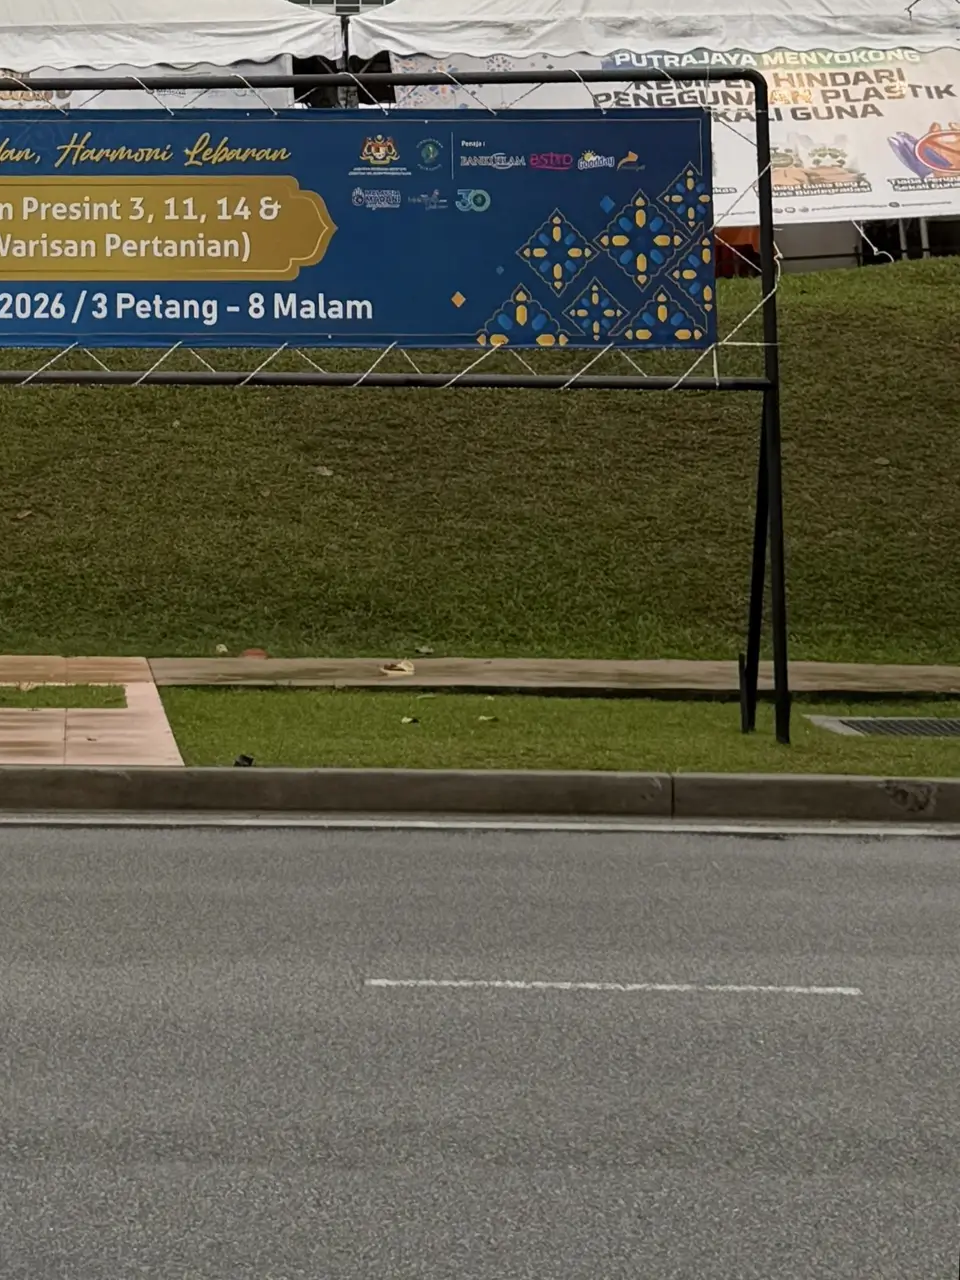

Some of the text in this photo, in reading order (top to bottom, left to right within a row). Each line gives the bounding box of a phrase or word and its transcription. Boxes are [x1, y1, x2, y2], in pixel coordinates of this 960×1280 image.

[615, 49, 921, 67] PUTRAJAYA MENYOKONG
[772, 68, 906, 88] HINDARI
[820, 84, 957, 104] PLASTIK
[790, 103, 884, 121] GUNA
[54, 132, 173, 168] Harmoni
[184, 132, 291, 167] Lebaran
[22, 196, 122, 220] Presint
[129, 197, 154, 224] 3,
[164, 197, 206, 223] 11,
[217, 197, 252, 220] 14
[259, 196, 282, 220] &
[105, 231, 250, 262] Pertanian)
[71, 290, 87, 324] /
[91, 292, 108, 319] 3
[116, 292, 218, 326] Petang
[248, 292, 265, 319] 8
[274, 292, 373, 319] Malam
